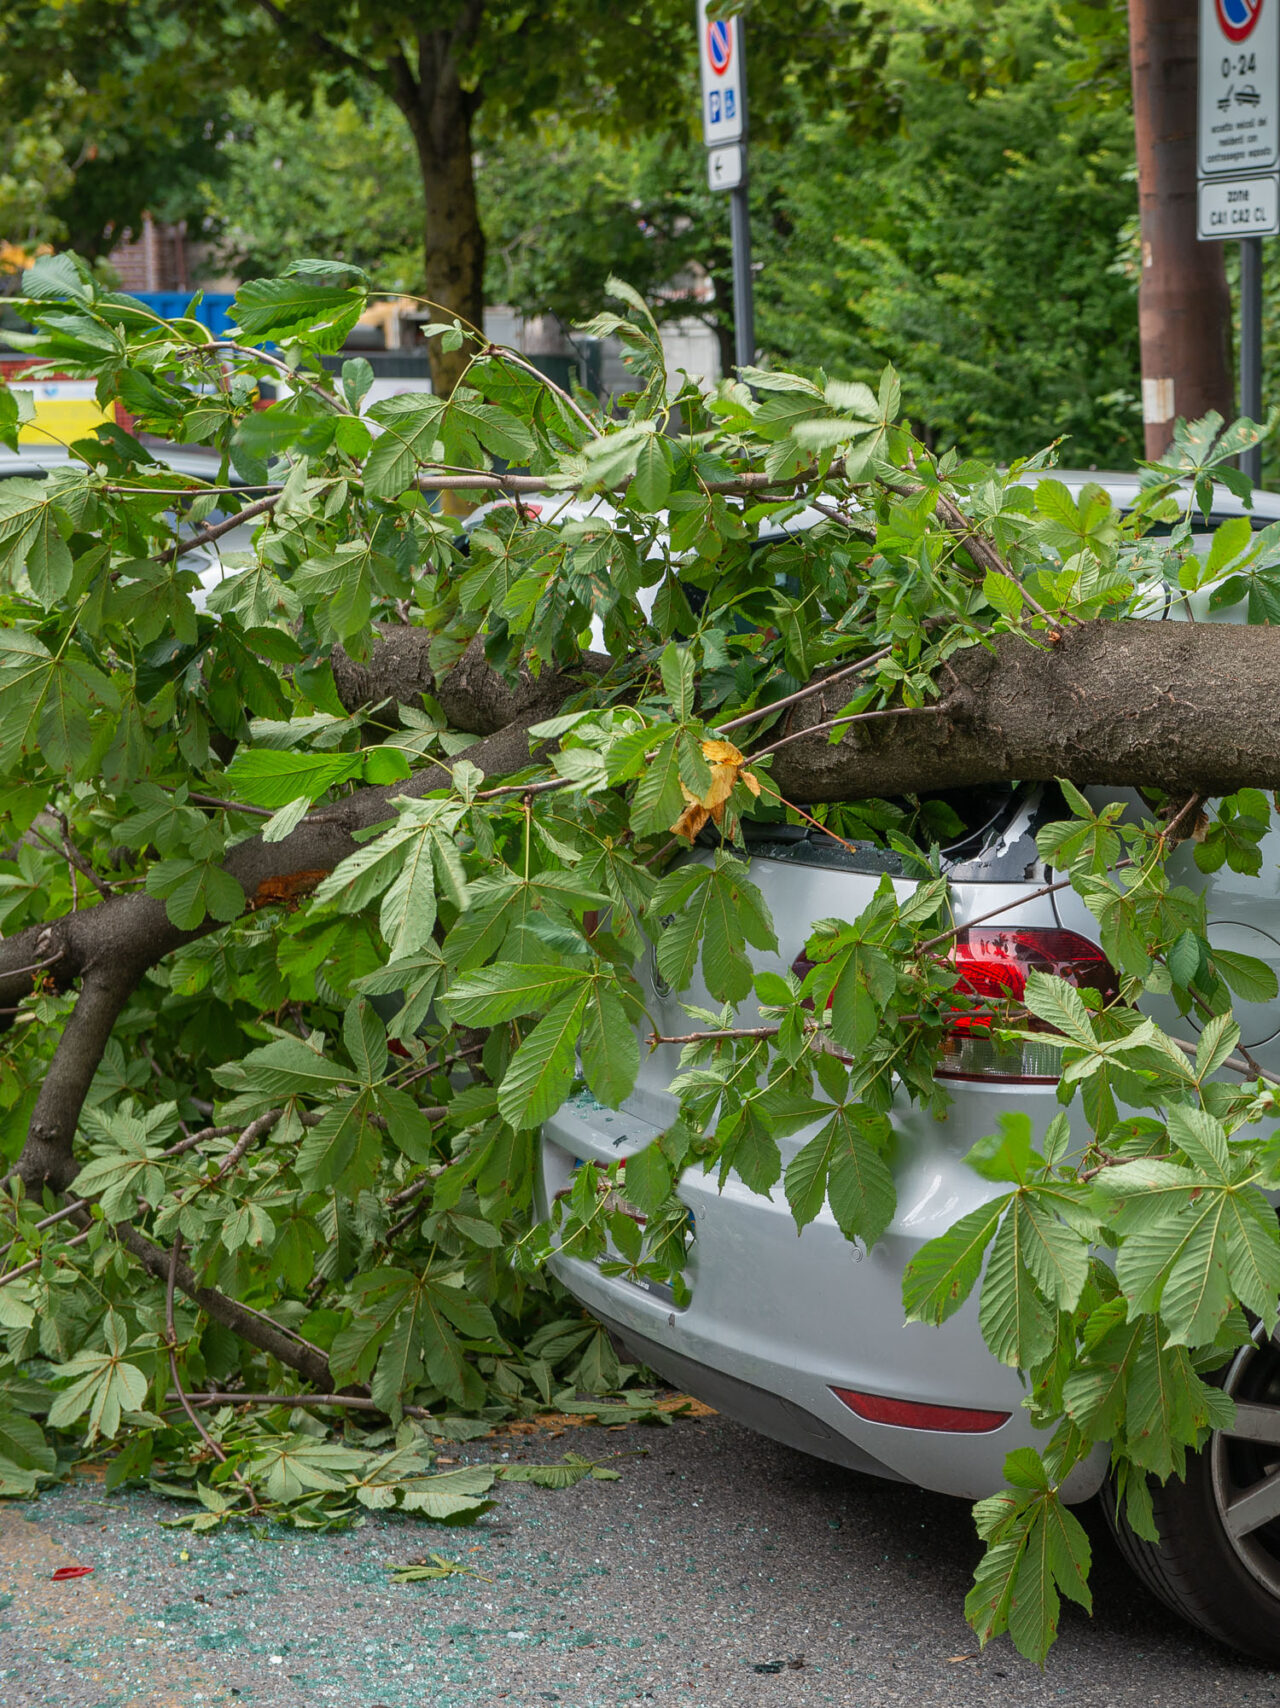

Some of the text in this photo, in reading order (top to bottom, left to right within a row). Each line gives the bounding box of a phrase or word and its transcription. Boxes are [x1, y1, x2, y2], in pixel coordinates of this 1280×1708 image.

[1221, 53, 1256, 78] 0-24
[1227, 190, 1249, 203] zone
[1210, 207, 1267, 226] CA1 CA2 CL
